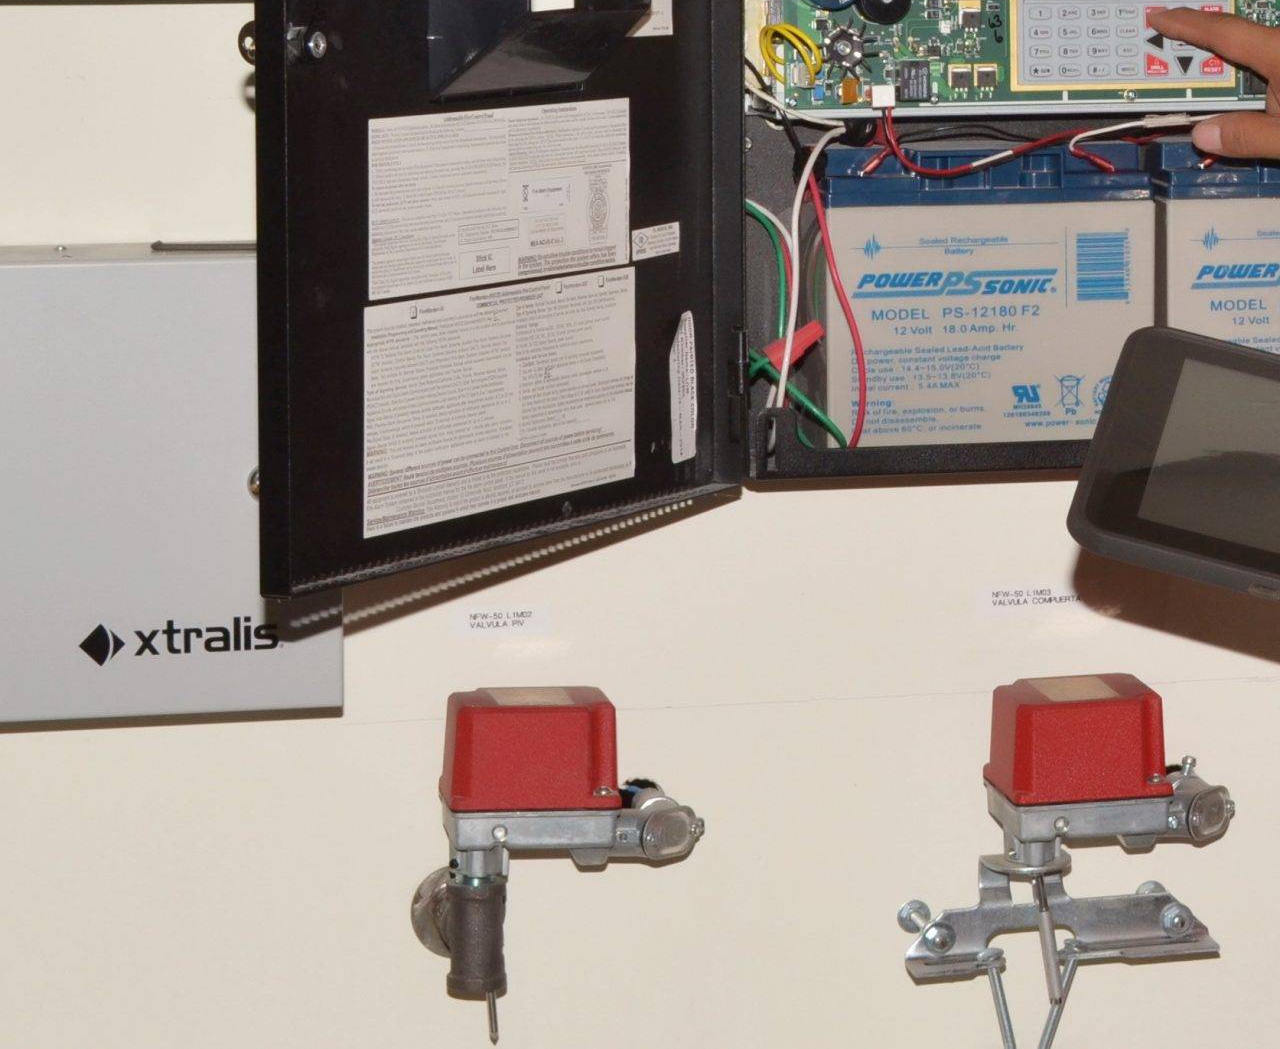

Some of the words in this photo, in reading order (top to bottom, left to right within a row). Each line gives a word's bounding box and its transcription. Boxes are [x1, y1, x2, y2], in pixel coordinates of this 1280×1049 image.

[948, 235, 1009, 247] Rechargeable
[944, 247, 974, 256] Battery
[1196, 263, 1279, 281] POWER
[857, 271, 940, 290] POWER
[981, 277, 1053, 296] SONIC
[1210, 297, 1268, 311] MODEL
[871, 308, 930, 322] MODEL
[942, 305, 1017, 320] PS-12180
[1021, 304, 1040, 317] F2
[1231, 317, 1245, 326] 12
[1247, 315, 1270, 325] Volt
[893, 326, 908, 336] 12
[909, 325, 933, 335] Volt
[942, 324, 968, 334] 18.0
[851, 348, 912, 357] Rchargeable
[851, 375, 887, 385] Sndby
[992, 590, 1024, 598] NFW-50
[992, 598, 1028, 606] VALVULA
[1032, 595, 1081, 605] COMPUERTA
[469, 612, 503, 620] NFW-50
[469, 621, 508, 629] VALVULA
[512, 619, 525, 627] PIV
[134, 616, 279, 656] xtralis
